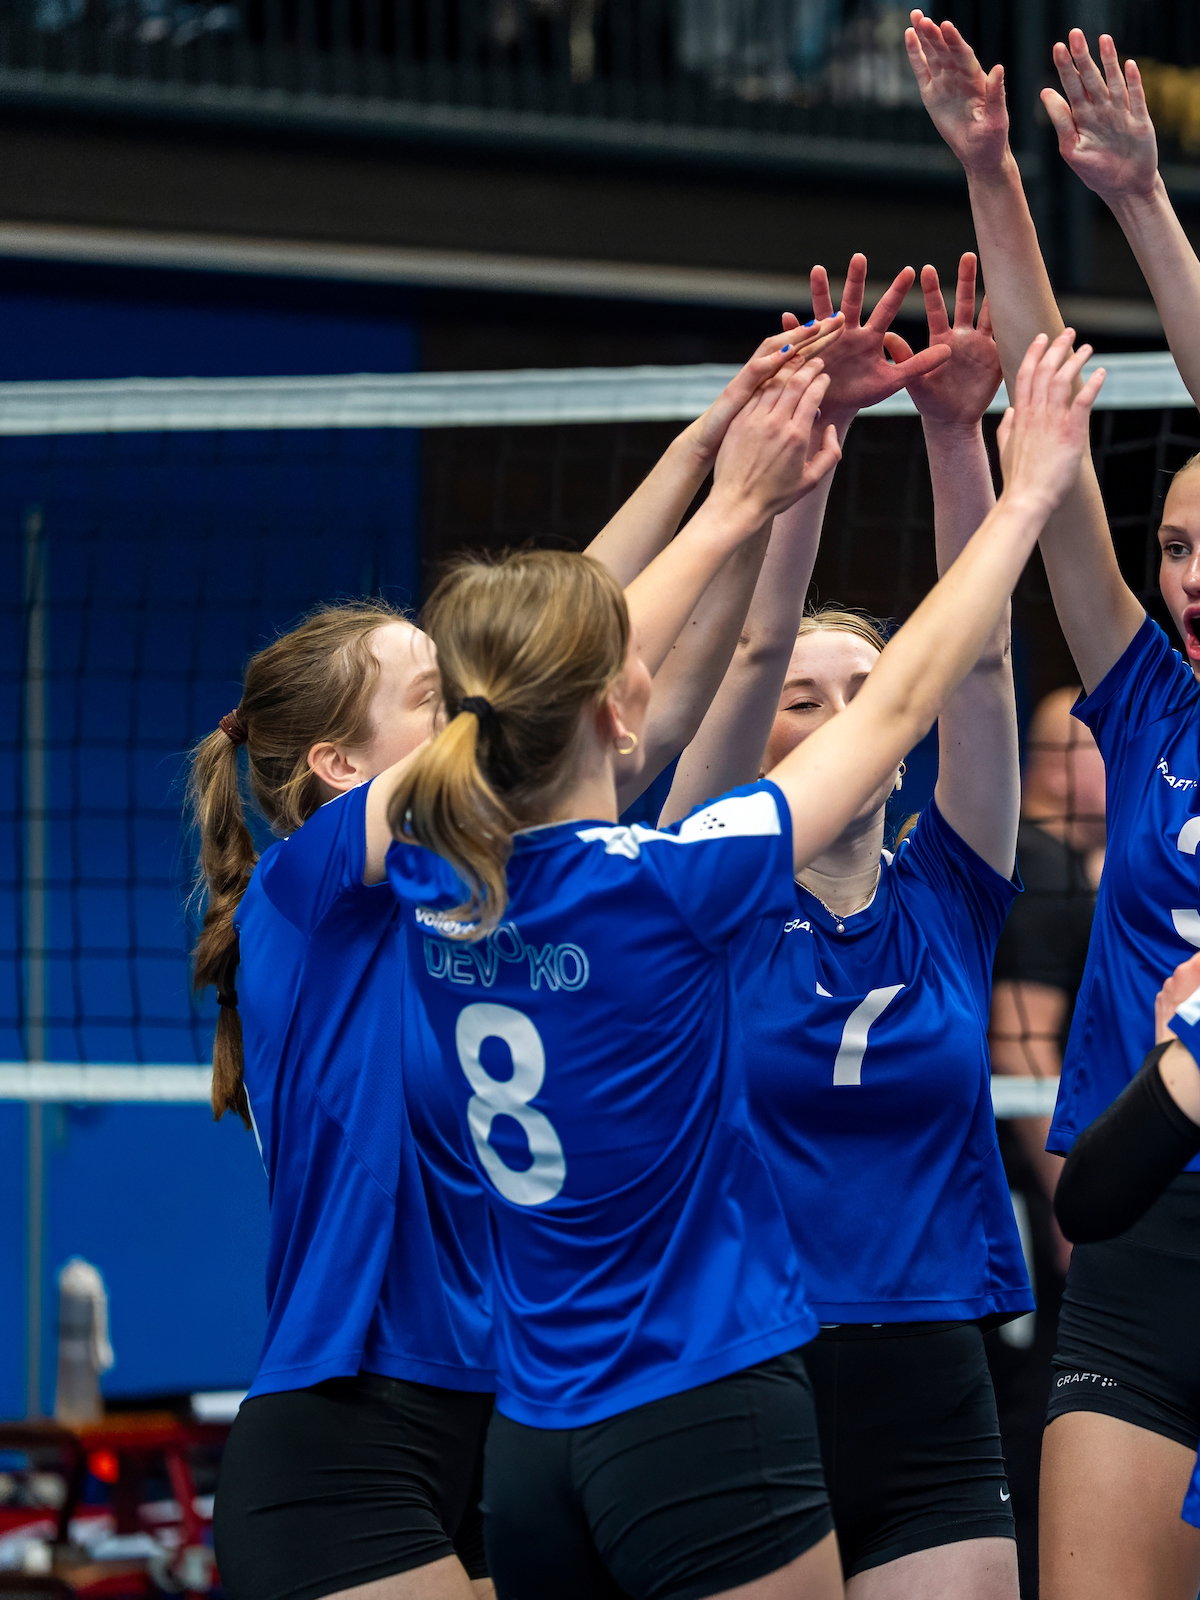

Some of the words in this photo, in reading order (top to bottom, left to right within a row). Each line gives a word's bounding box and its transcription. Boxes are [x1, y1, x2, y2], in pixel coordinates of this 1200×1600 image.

[1157, 757, 1193, 791] RAFT
[816, 982, 906, 1086] 7
[455, 1003, 566, 1206] 8
[1056, 1373, 1101, 1387] CRAFT
